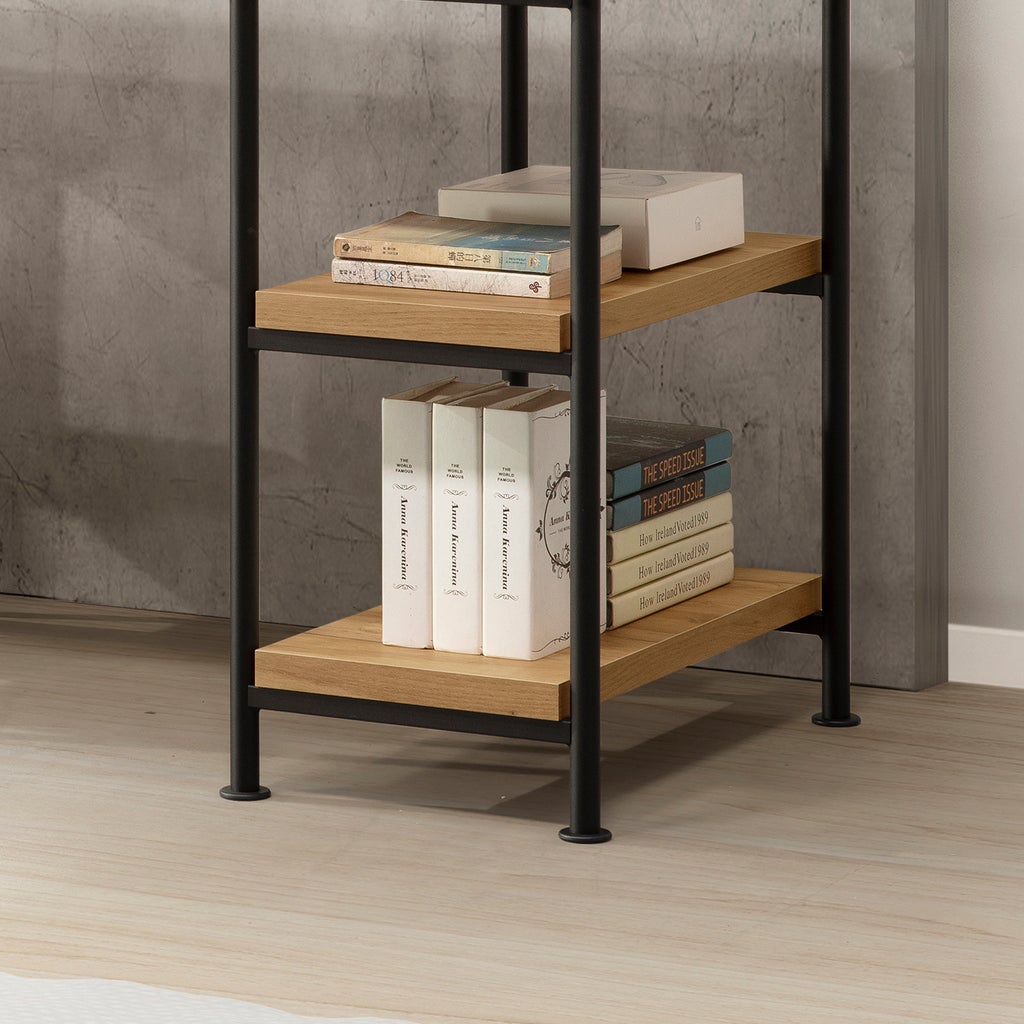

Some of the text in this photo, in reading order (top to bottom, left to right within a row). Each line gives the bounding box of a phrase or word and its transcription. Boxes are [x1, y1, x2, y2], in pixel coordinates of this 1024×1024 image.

[373, 269, 404, 285] 1Q84
[643, 446, 705, 485] THE SPEED ISSUE
[643, 479, 704, 517] THE SPEED ISSUE
[400, 495, 409, 580] Anna Karenina
[451, 501, 459, 586] Anna Karenina
[502, 504, 510, 590] Anna Karenina
[639, 533, 653, 547] How
[638, 566, 653, 579] How
[639, 596, 654, 610] How
